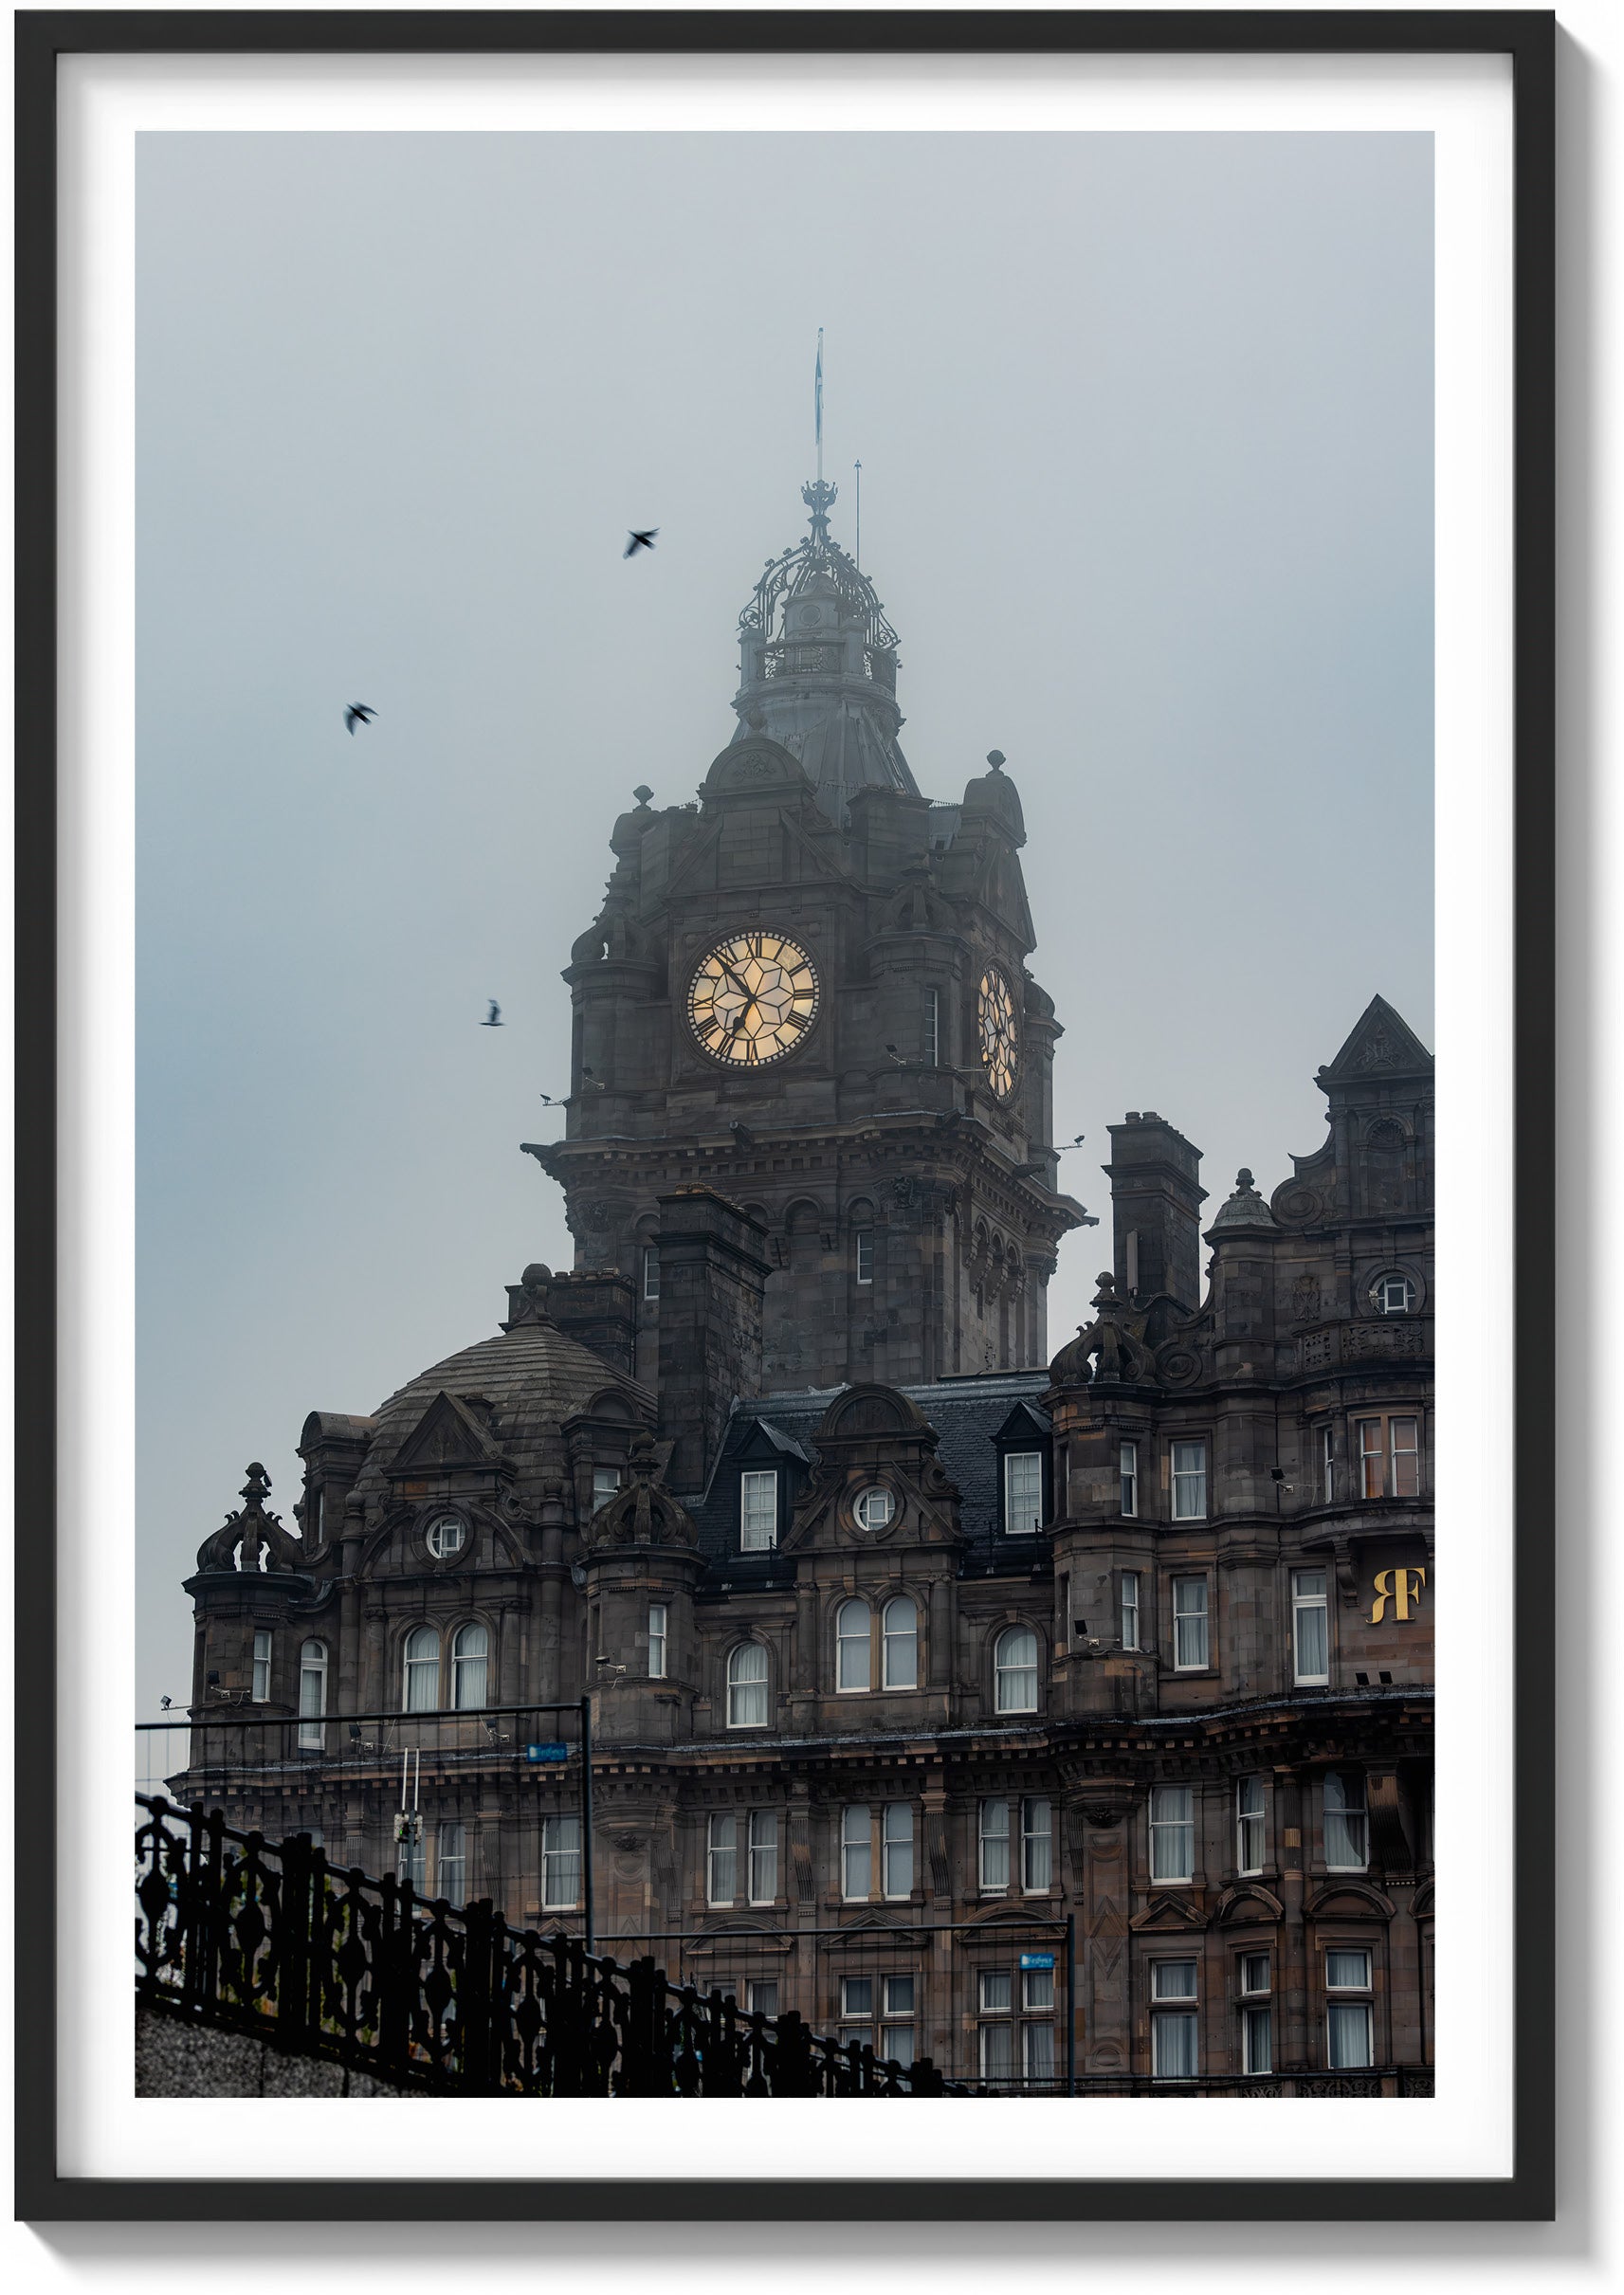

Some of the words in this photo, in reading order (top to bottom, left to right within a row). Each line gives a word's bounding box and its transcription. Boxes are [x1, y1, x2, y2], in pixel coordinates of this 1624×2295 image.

[745, 937, 762, 958] XII
[788, 961, 807, 977] II
[794, 988, 814, 1000] III
